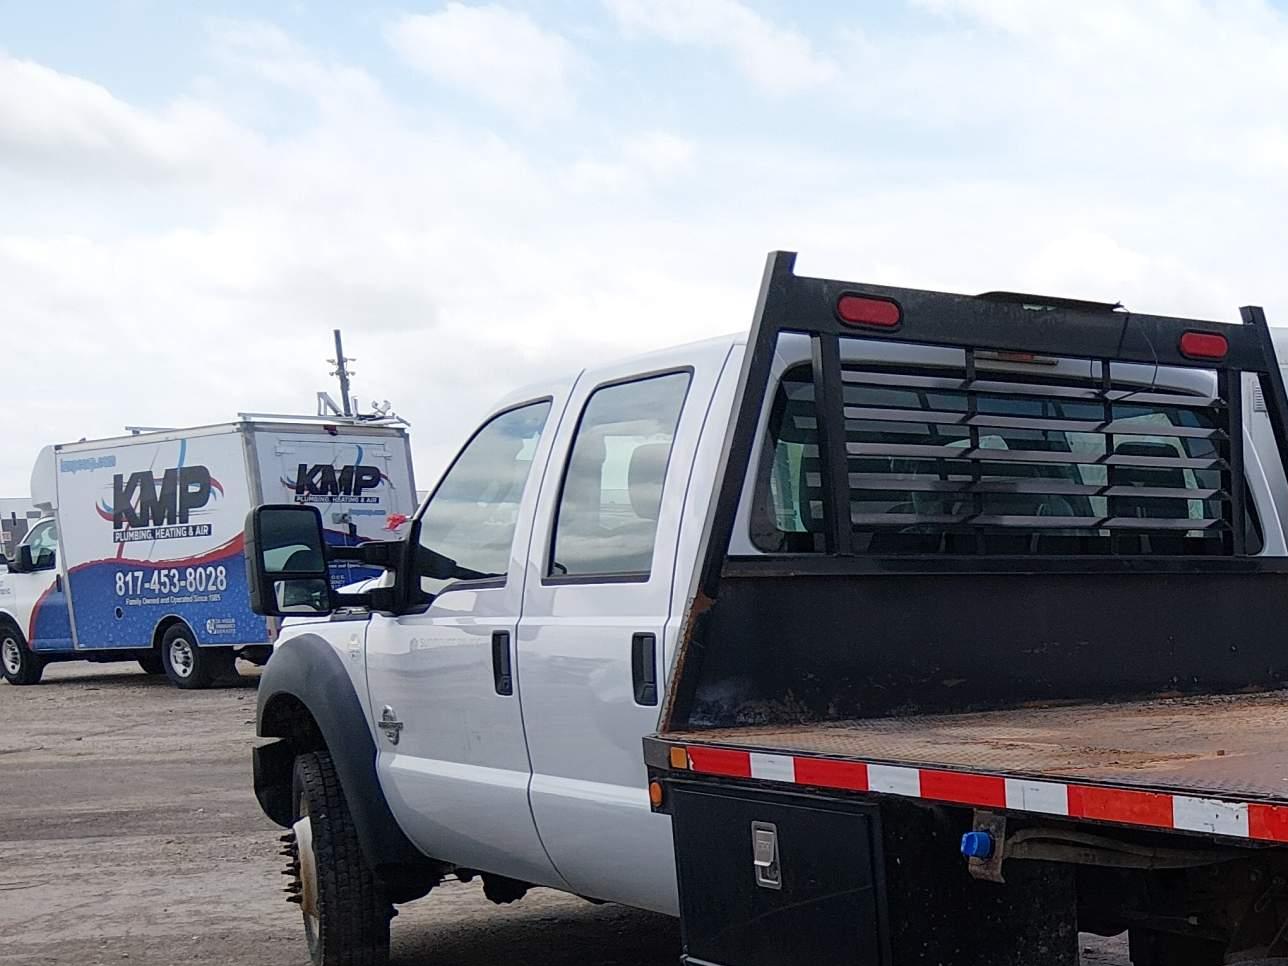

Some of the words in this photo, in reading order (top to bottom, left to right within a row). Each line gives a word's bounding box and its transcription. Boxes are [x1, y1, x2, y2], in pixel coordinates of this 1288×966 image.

[295, 464, 381, 496] KMP
[113, 465, 211, 530] KMP
[115, 529, 154, 542] PLUMBING,
[155, 527, 187, 539] HEATING
[188, 526, 194, 536] &
[195, 525, 209, 536] AIR
[115, 565, 227, 596] 817-453-8028
